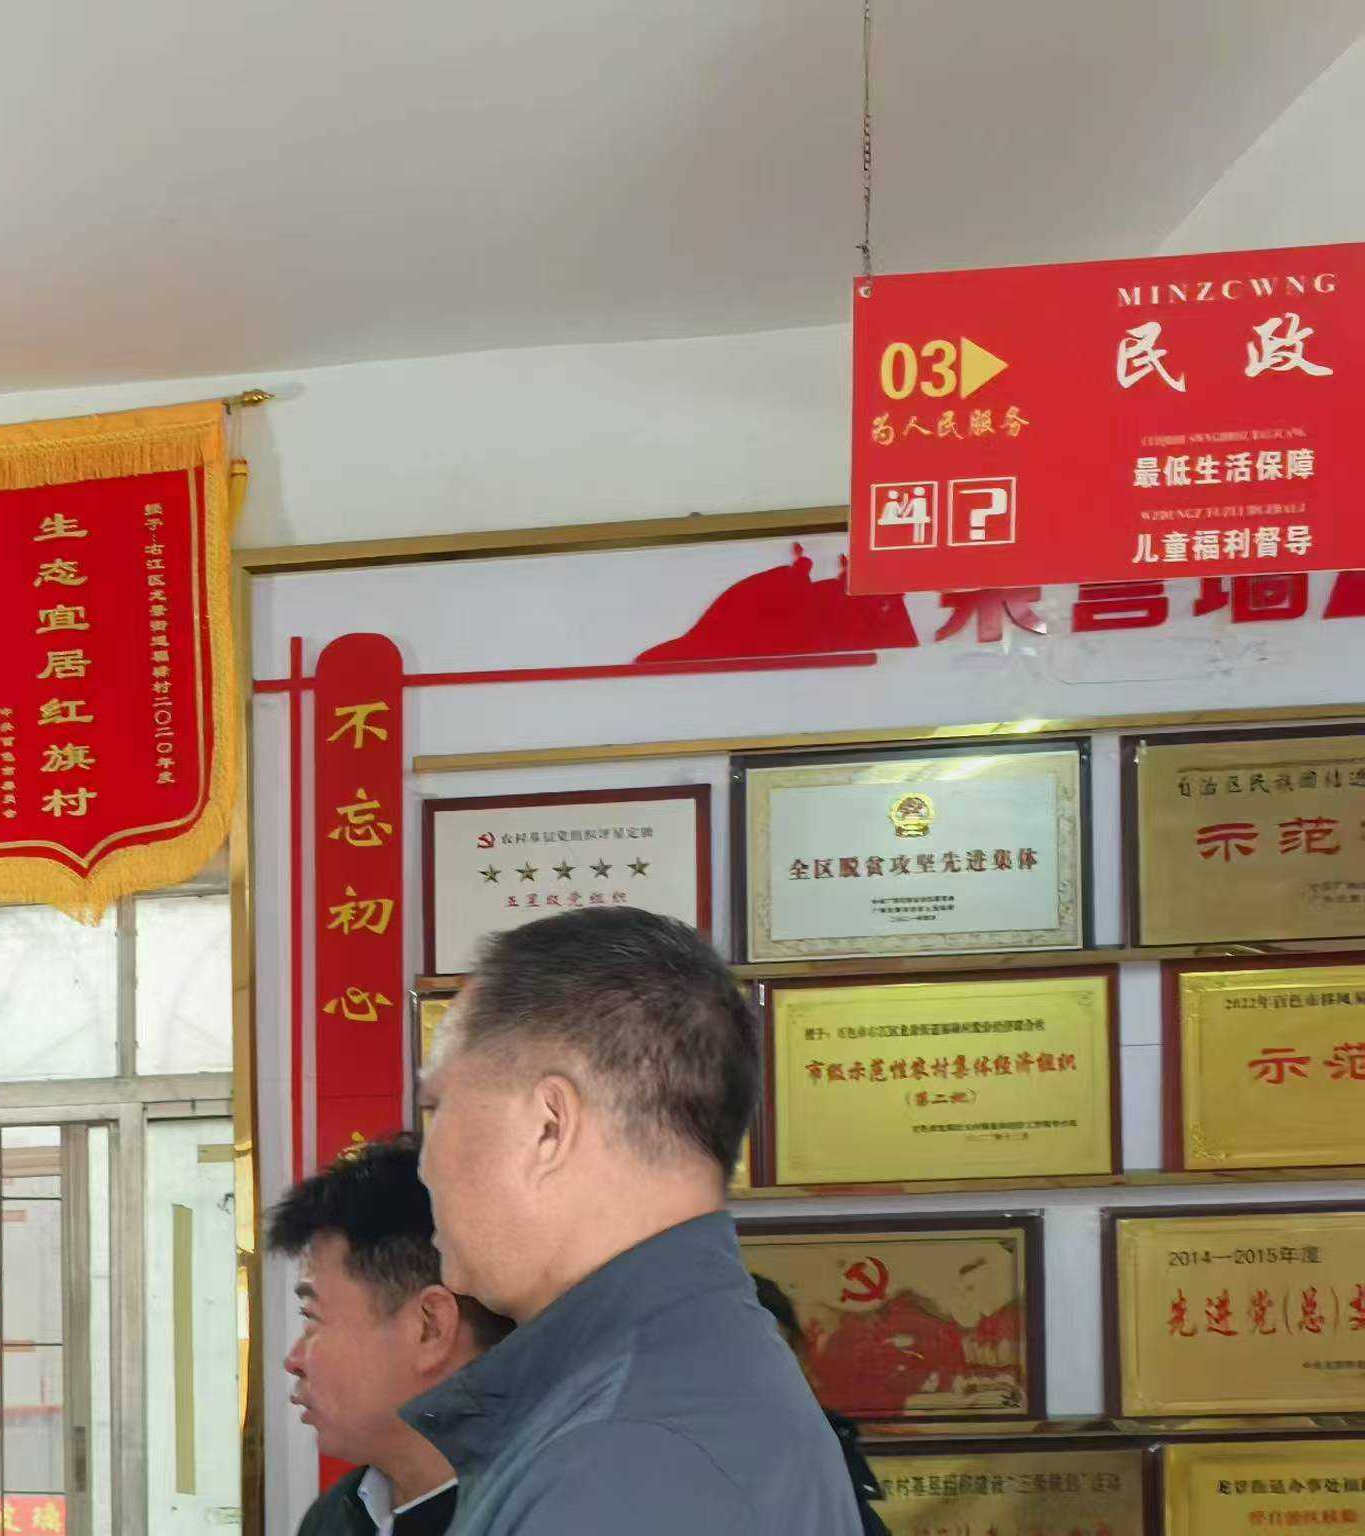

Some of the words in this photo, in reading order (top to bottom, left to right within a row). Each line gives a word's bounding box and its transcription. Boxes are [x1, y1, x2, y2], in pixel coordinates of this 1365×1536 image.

[1117, 273, 1335, 306] MINZCWNG
[880, 339, 957, 400] 03
[1116, 312, 1334, 393] 民政
[871, 405, 1030, 446] 为人民服务
[1133, 447, 1315, 489] 最低生活保障
[1132, 525, 1312, 564] 儿童福利督导
[33, 512, 98, 818] 生态宜居红旗村
[1195, 816, 1365, 862] 示范
[322, 700, 395, 1022] 不忘初心
[788, 847, 1039, 880] 全区脱贫攻坚先进集体
[804, 1052, 1077, 1084] 市级示范性农村集体经济组织
[1247, 1042, 1365, 1084] 示范
